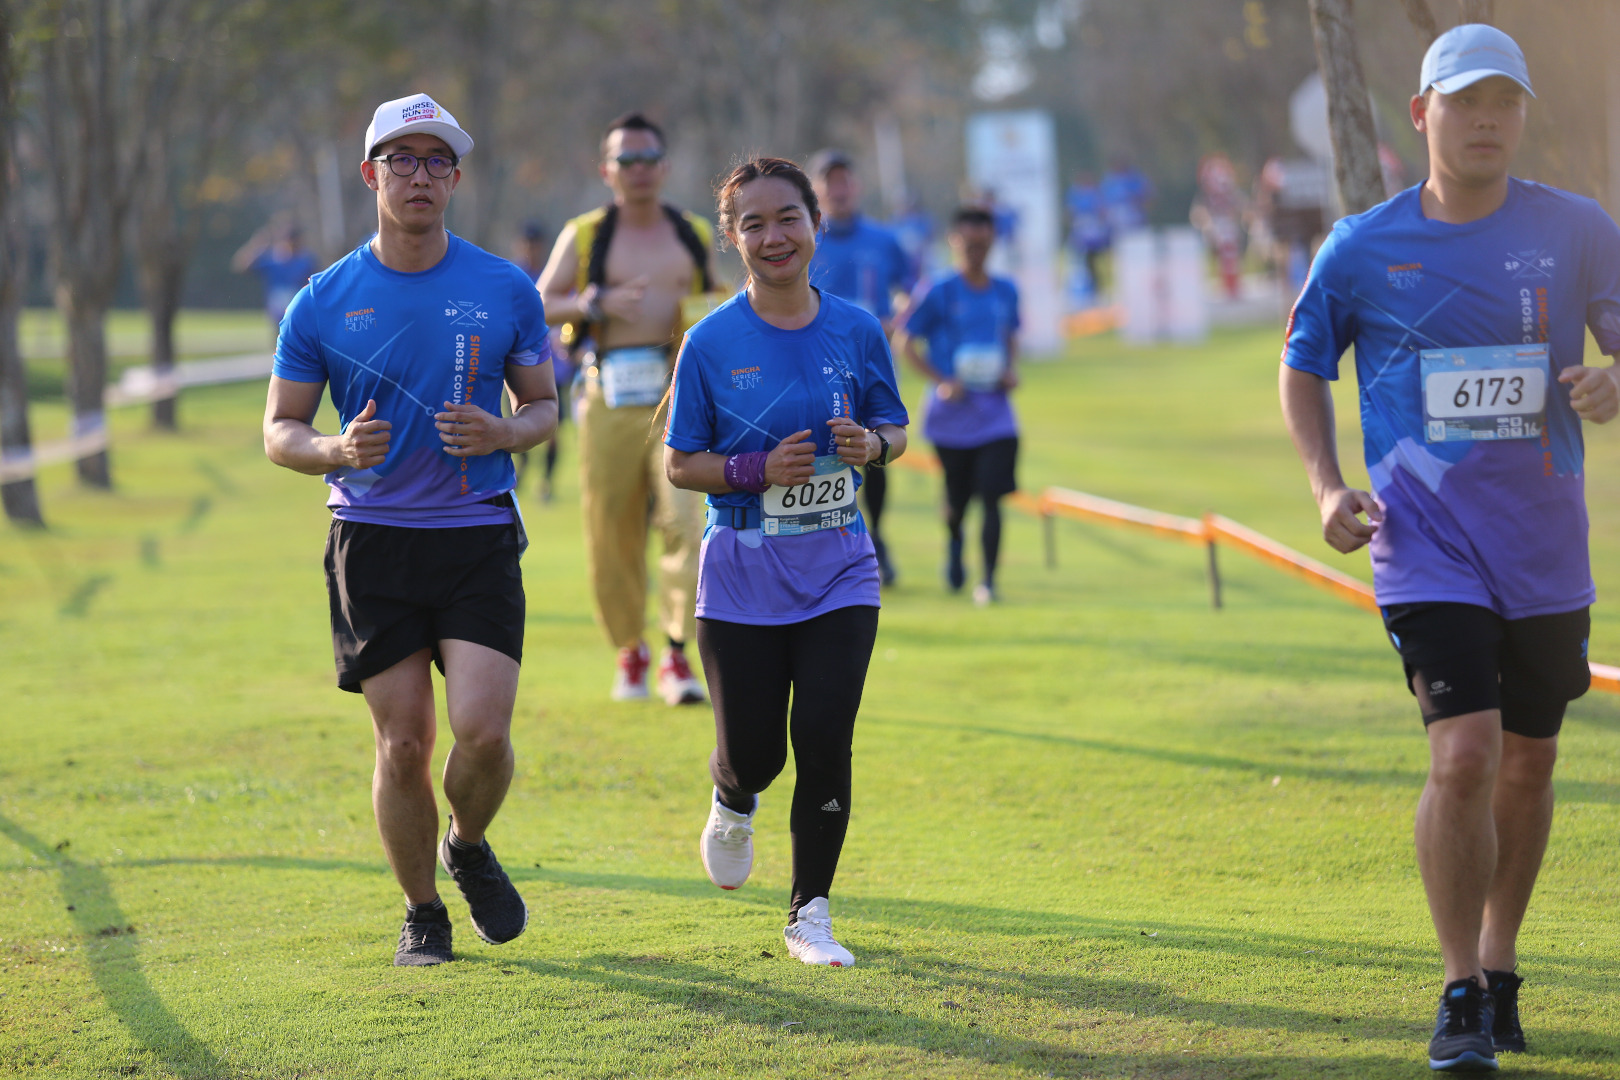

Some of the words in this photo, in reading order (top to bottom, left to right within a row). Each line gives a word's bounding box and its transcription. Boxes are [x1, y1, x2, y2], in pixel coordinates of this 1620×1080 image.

[403, 102, 435, 113] NURSES
[403, 109, 421, 119] RUN
[1504, 261, 1519, 270] SP
[1539, 258, 1554, 267] XC
[345, 308, 375, 318] SINGHA
[445, 309, 458, 317] SP
[475, 311, 488, 319] XC
[1520, 288, 1533, 332] CROSS
[455, 334, 464, 372] CROSS
[467, 335, 480, 383] SINGHA
[731, 366, 760, 376] SINGHA
[823, 367, 834, 375] SP
[453, 374, 463, 405] COUN
[465, 386, 474, 405] PA
[1453, 376, 1524, 408] 6173
[833, 392, 841, 417] CRO
[843, 393, 851, 418] SIN
[1431, 425, 1443, 437] M
[460, 475, 469, 495] RAI
[782, 477, 846, 508] 6028
[768, 521, 776, 532] F
